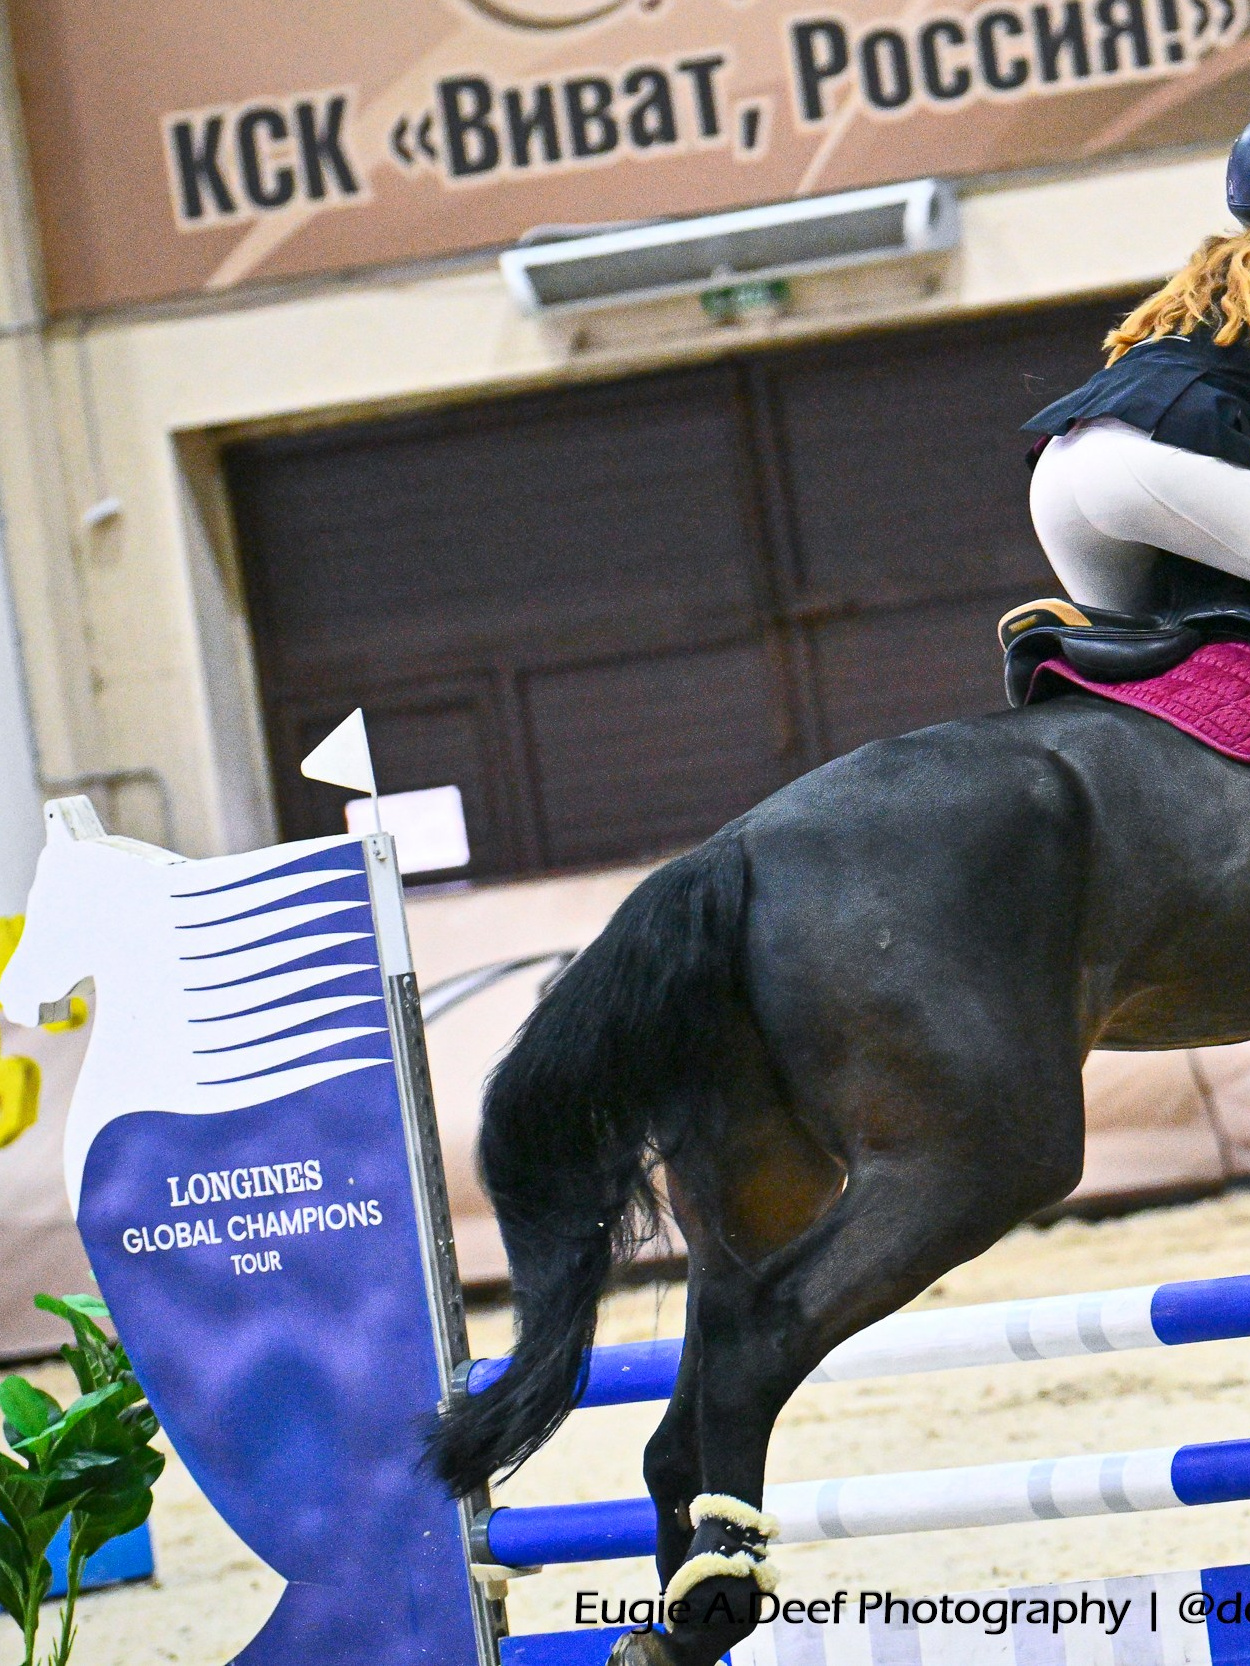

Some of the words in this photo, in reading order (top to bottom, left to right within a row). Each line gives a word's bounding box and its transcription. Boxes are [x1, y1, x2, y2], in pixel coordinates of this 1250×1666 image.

[170, 94, 360, 221] КСК
[390, 56, 763, 178] «Виват,
[789, 0, 1239, 121] Россия!»
[167, 1159, 323, 1207] LONGINES
[122, 1218, 222, 1254] GLOBAL
[227, 1199, 383, 1242] CHAMPIONS
[230, 1250, 282, 1275] TOUR
